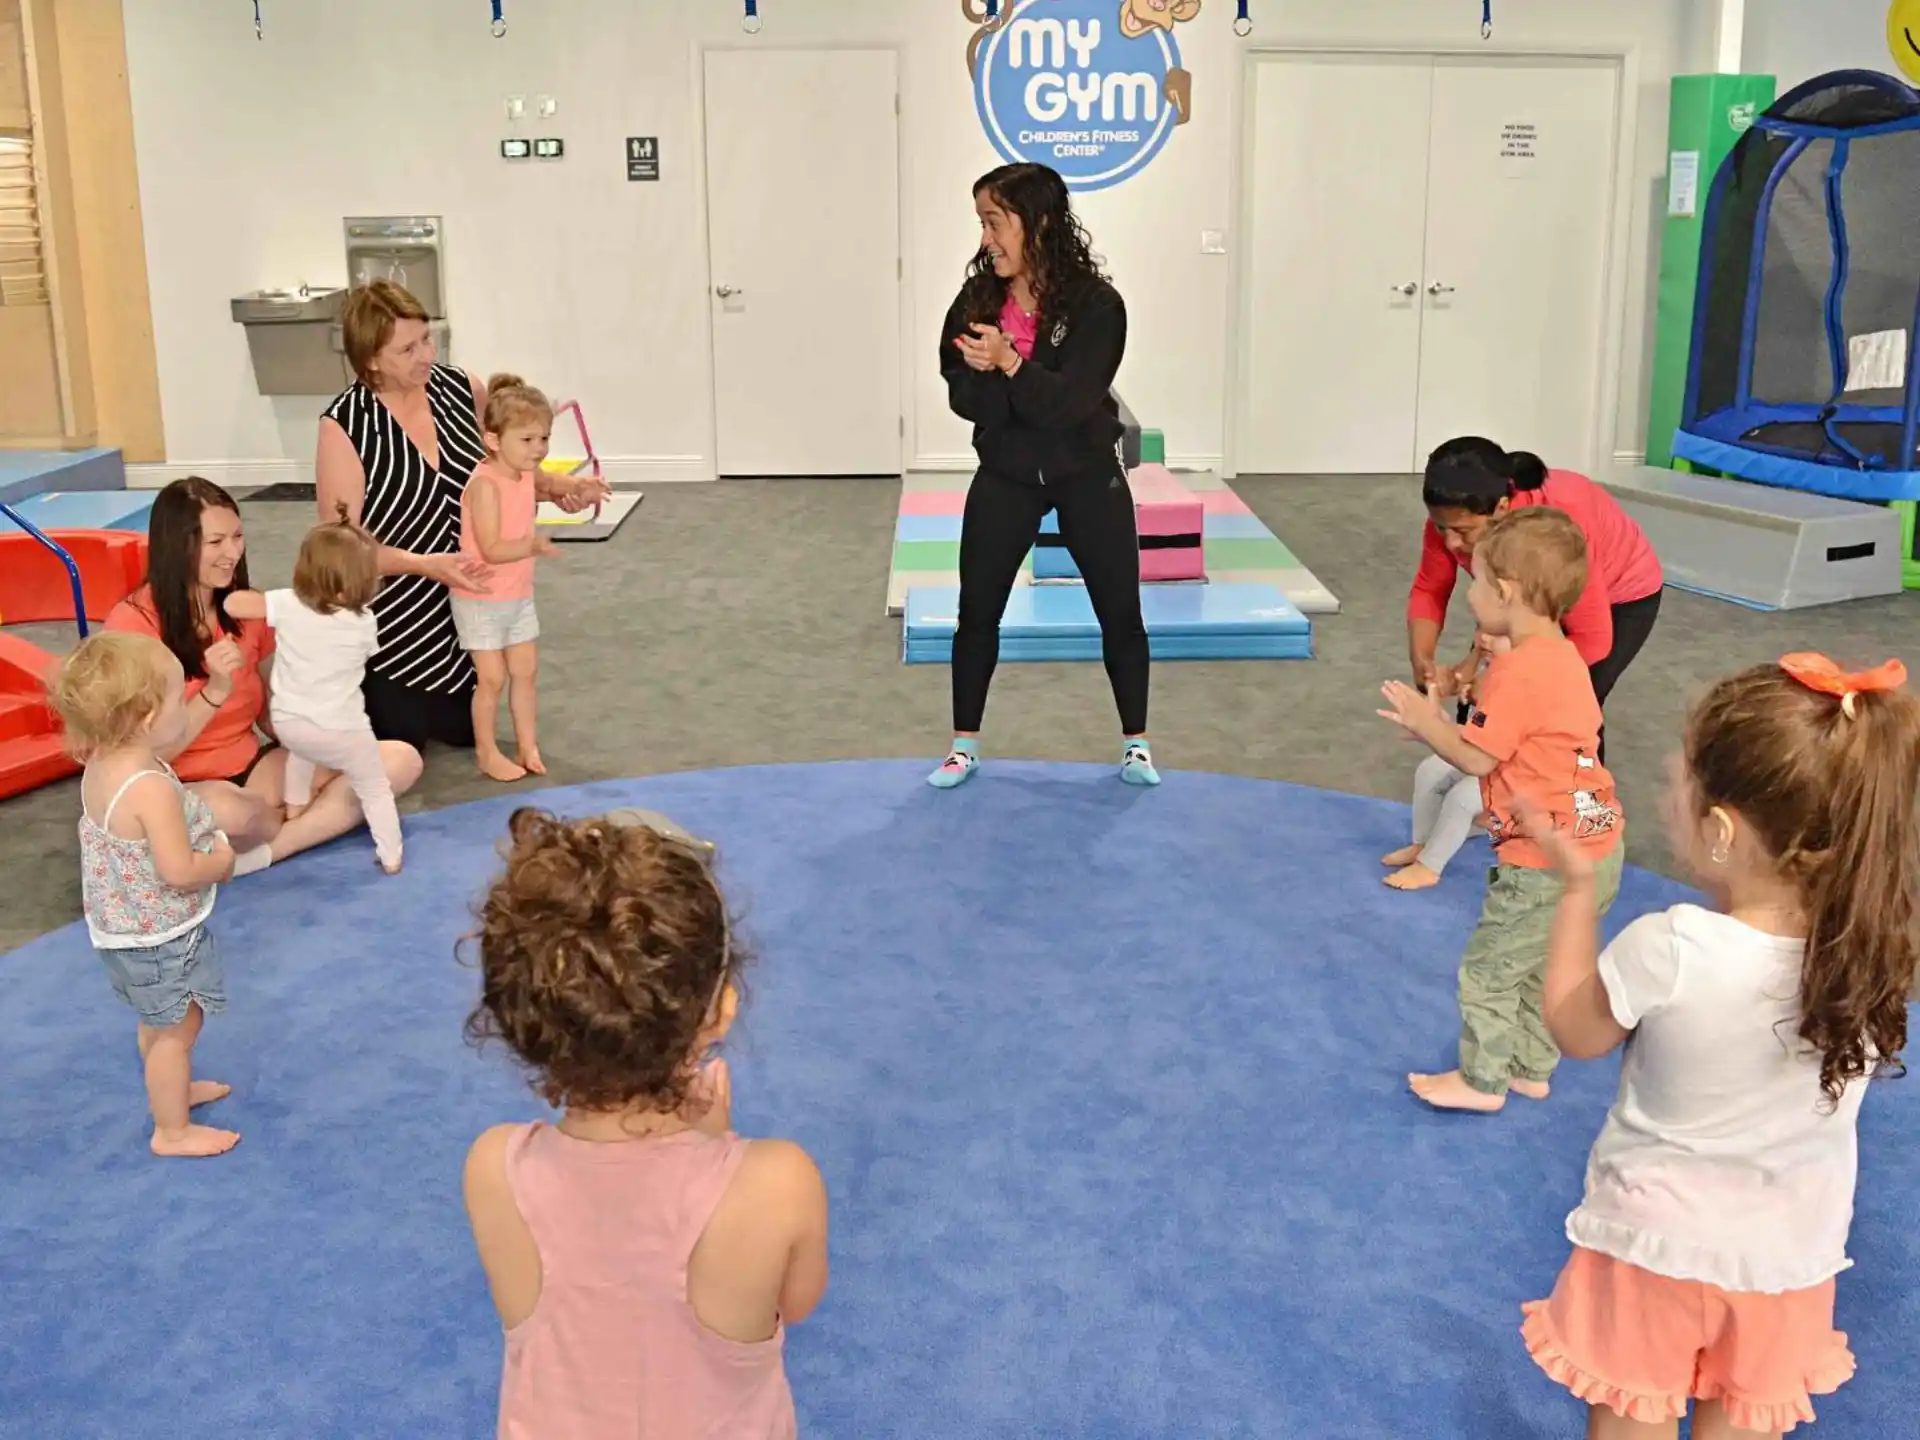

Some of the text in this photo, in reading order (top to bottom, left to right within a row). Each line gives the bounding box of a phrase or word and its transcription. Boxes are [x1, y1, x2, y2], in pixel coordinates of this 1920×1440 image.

[1008, 18, 1101, 69] MY
[1024, 71, 1158, 122] GYM
[1018, 130, 1140, 143] CHILDREN'S FITNESS
